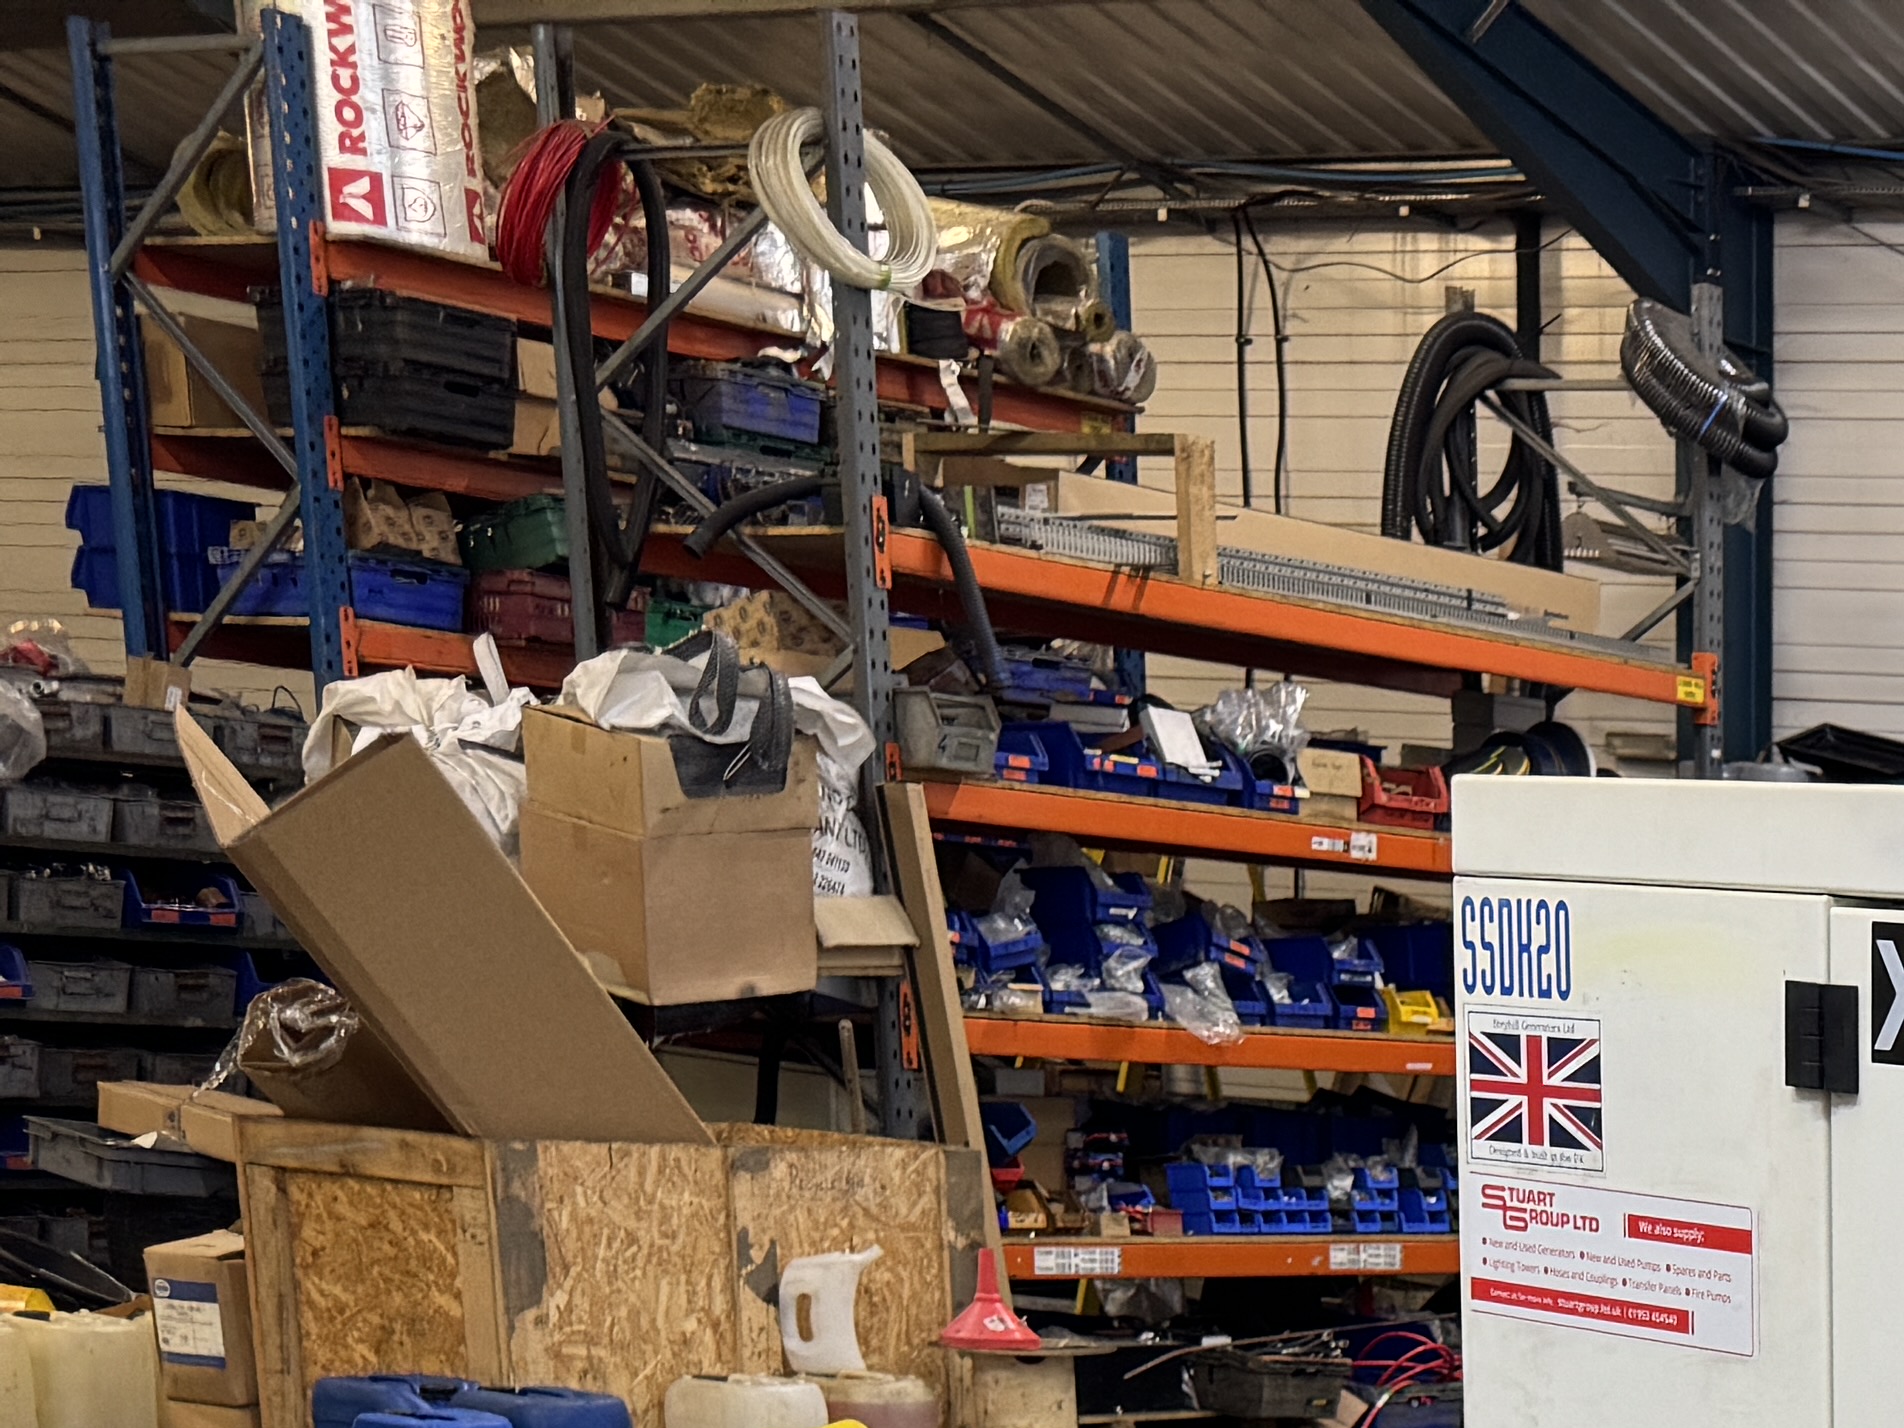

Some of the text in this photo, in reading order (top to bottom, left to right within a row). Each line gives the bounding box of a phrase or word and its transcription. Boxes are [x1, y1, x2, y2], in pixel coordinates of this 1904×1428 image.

[1461, 895, 1571, 1001] SSDK20
[1482, 1184, 1555, 1209] STUART
[1503, 1206, 1600, 1233] GROUP LTD
